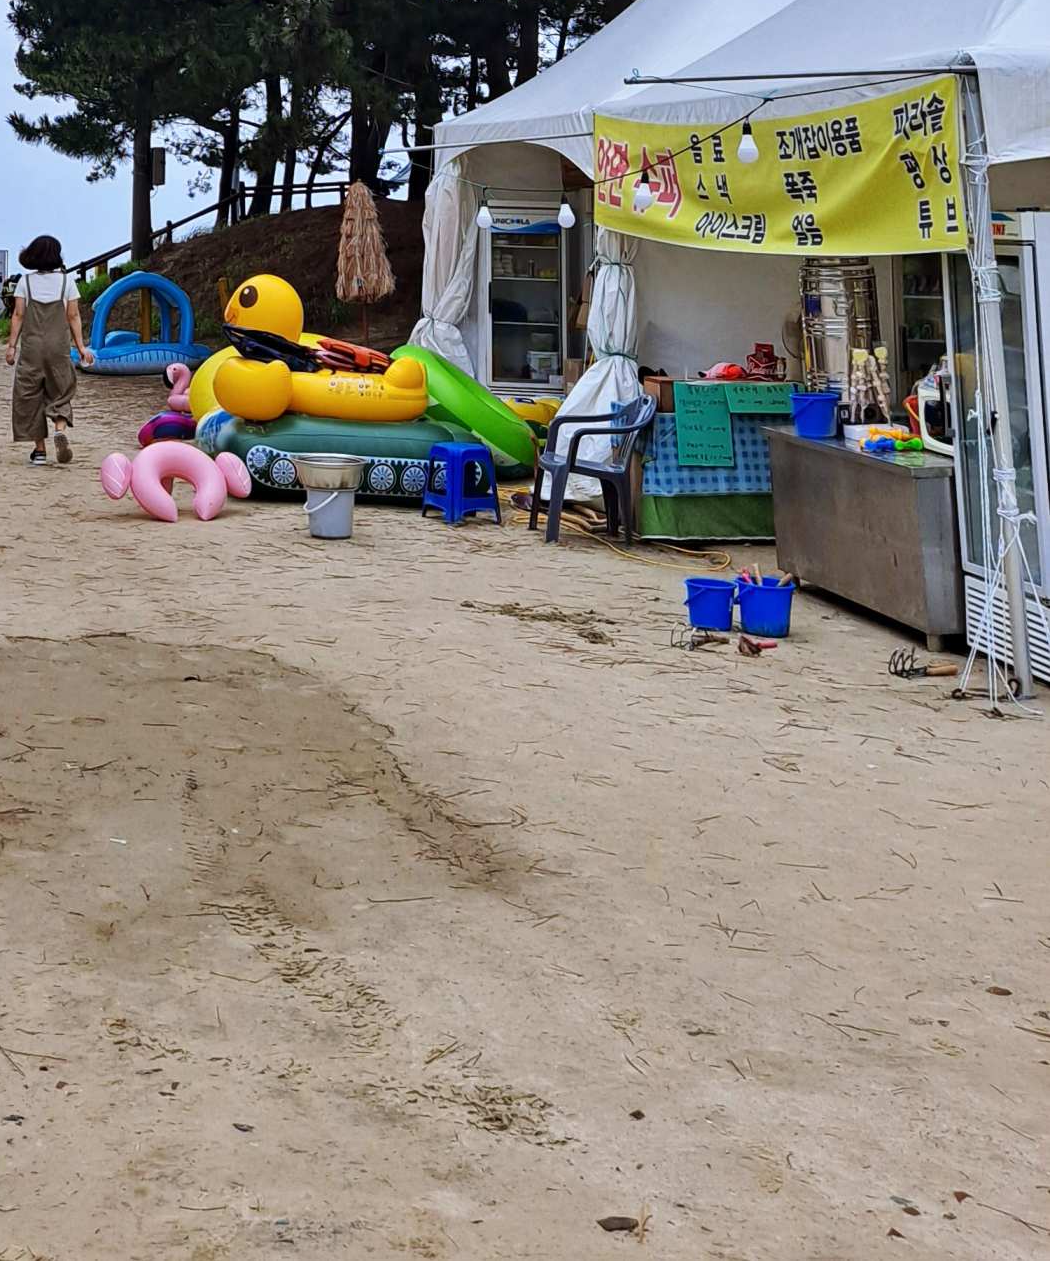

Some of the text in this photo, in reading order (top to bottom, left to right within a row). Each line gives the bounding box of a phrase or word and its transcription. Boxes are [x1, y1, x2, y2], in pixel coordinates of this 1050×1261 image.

[776, 117, 862, 160] 조개잡이용품
[784, 171, 817, 203] 폭죽
[695, 211, 766, 244] 아이스크림
[792, 214, 823, 246] 얼음
